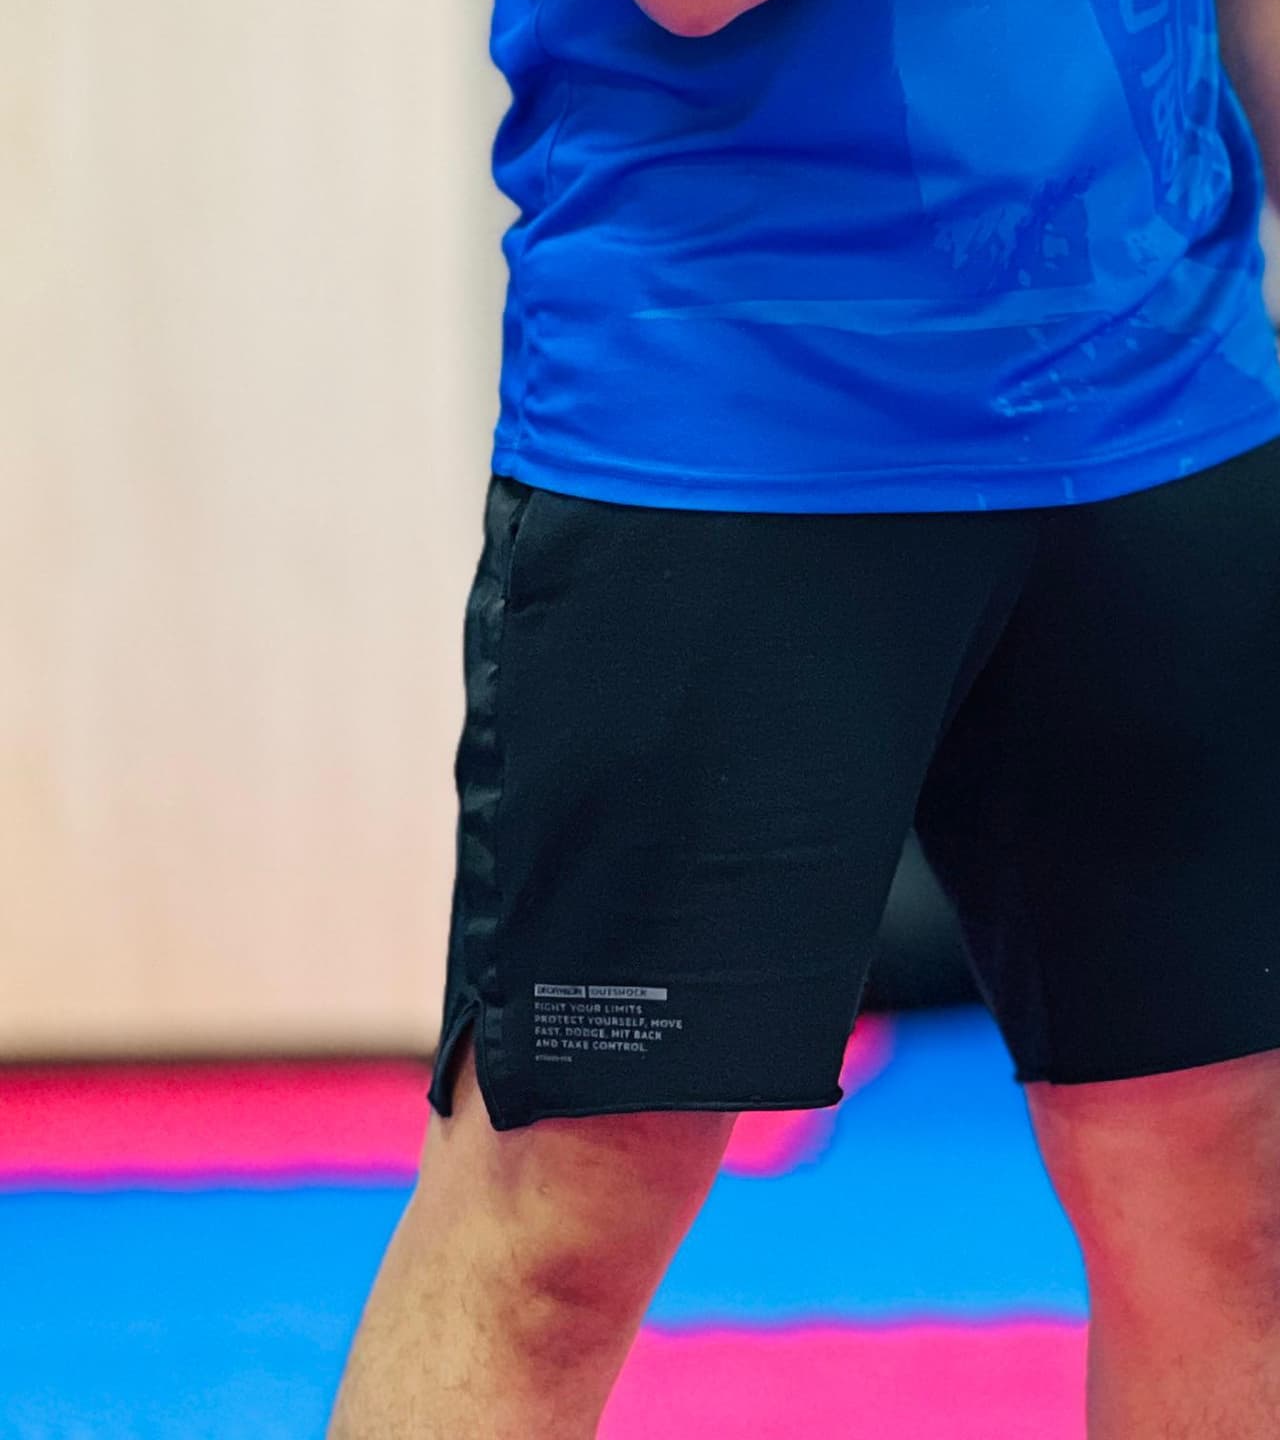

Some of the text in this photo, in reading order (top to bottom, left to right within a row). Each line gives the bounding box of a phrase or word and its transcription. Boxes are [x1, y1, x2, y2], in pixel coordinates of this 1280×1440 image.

[534, 1002, 643, 1015] FIGHT YOUR LIMITS
[534, 1015, 585, 1026] PROTECT
[650, 1019, 683, 1030] MOVE
[611, 1029, 631, 1040] HIT
[633, 1030, 663, 1041] BACK
[535, 1038, 559, 1049] AND
[561, 1039, 589, 1051] TAKE
